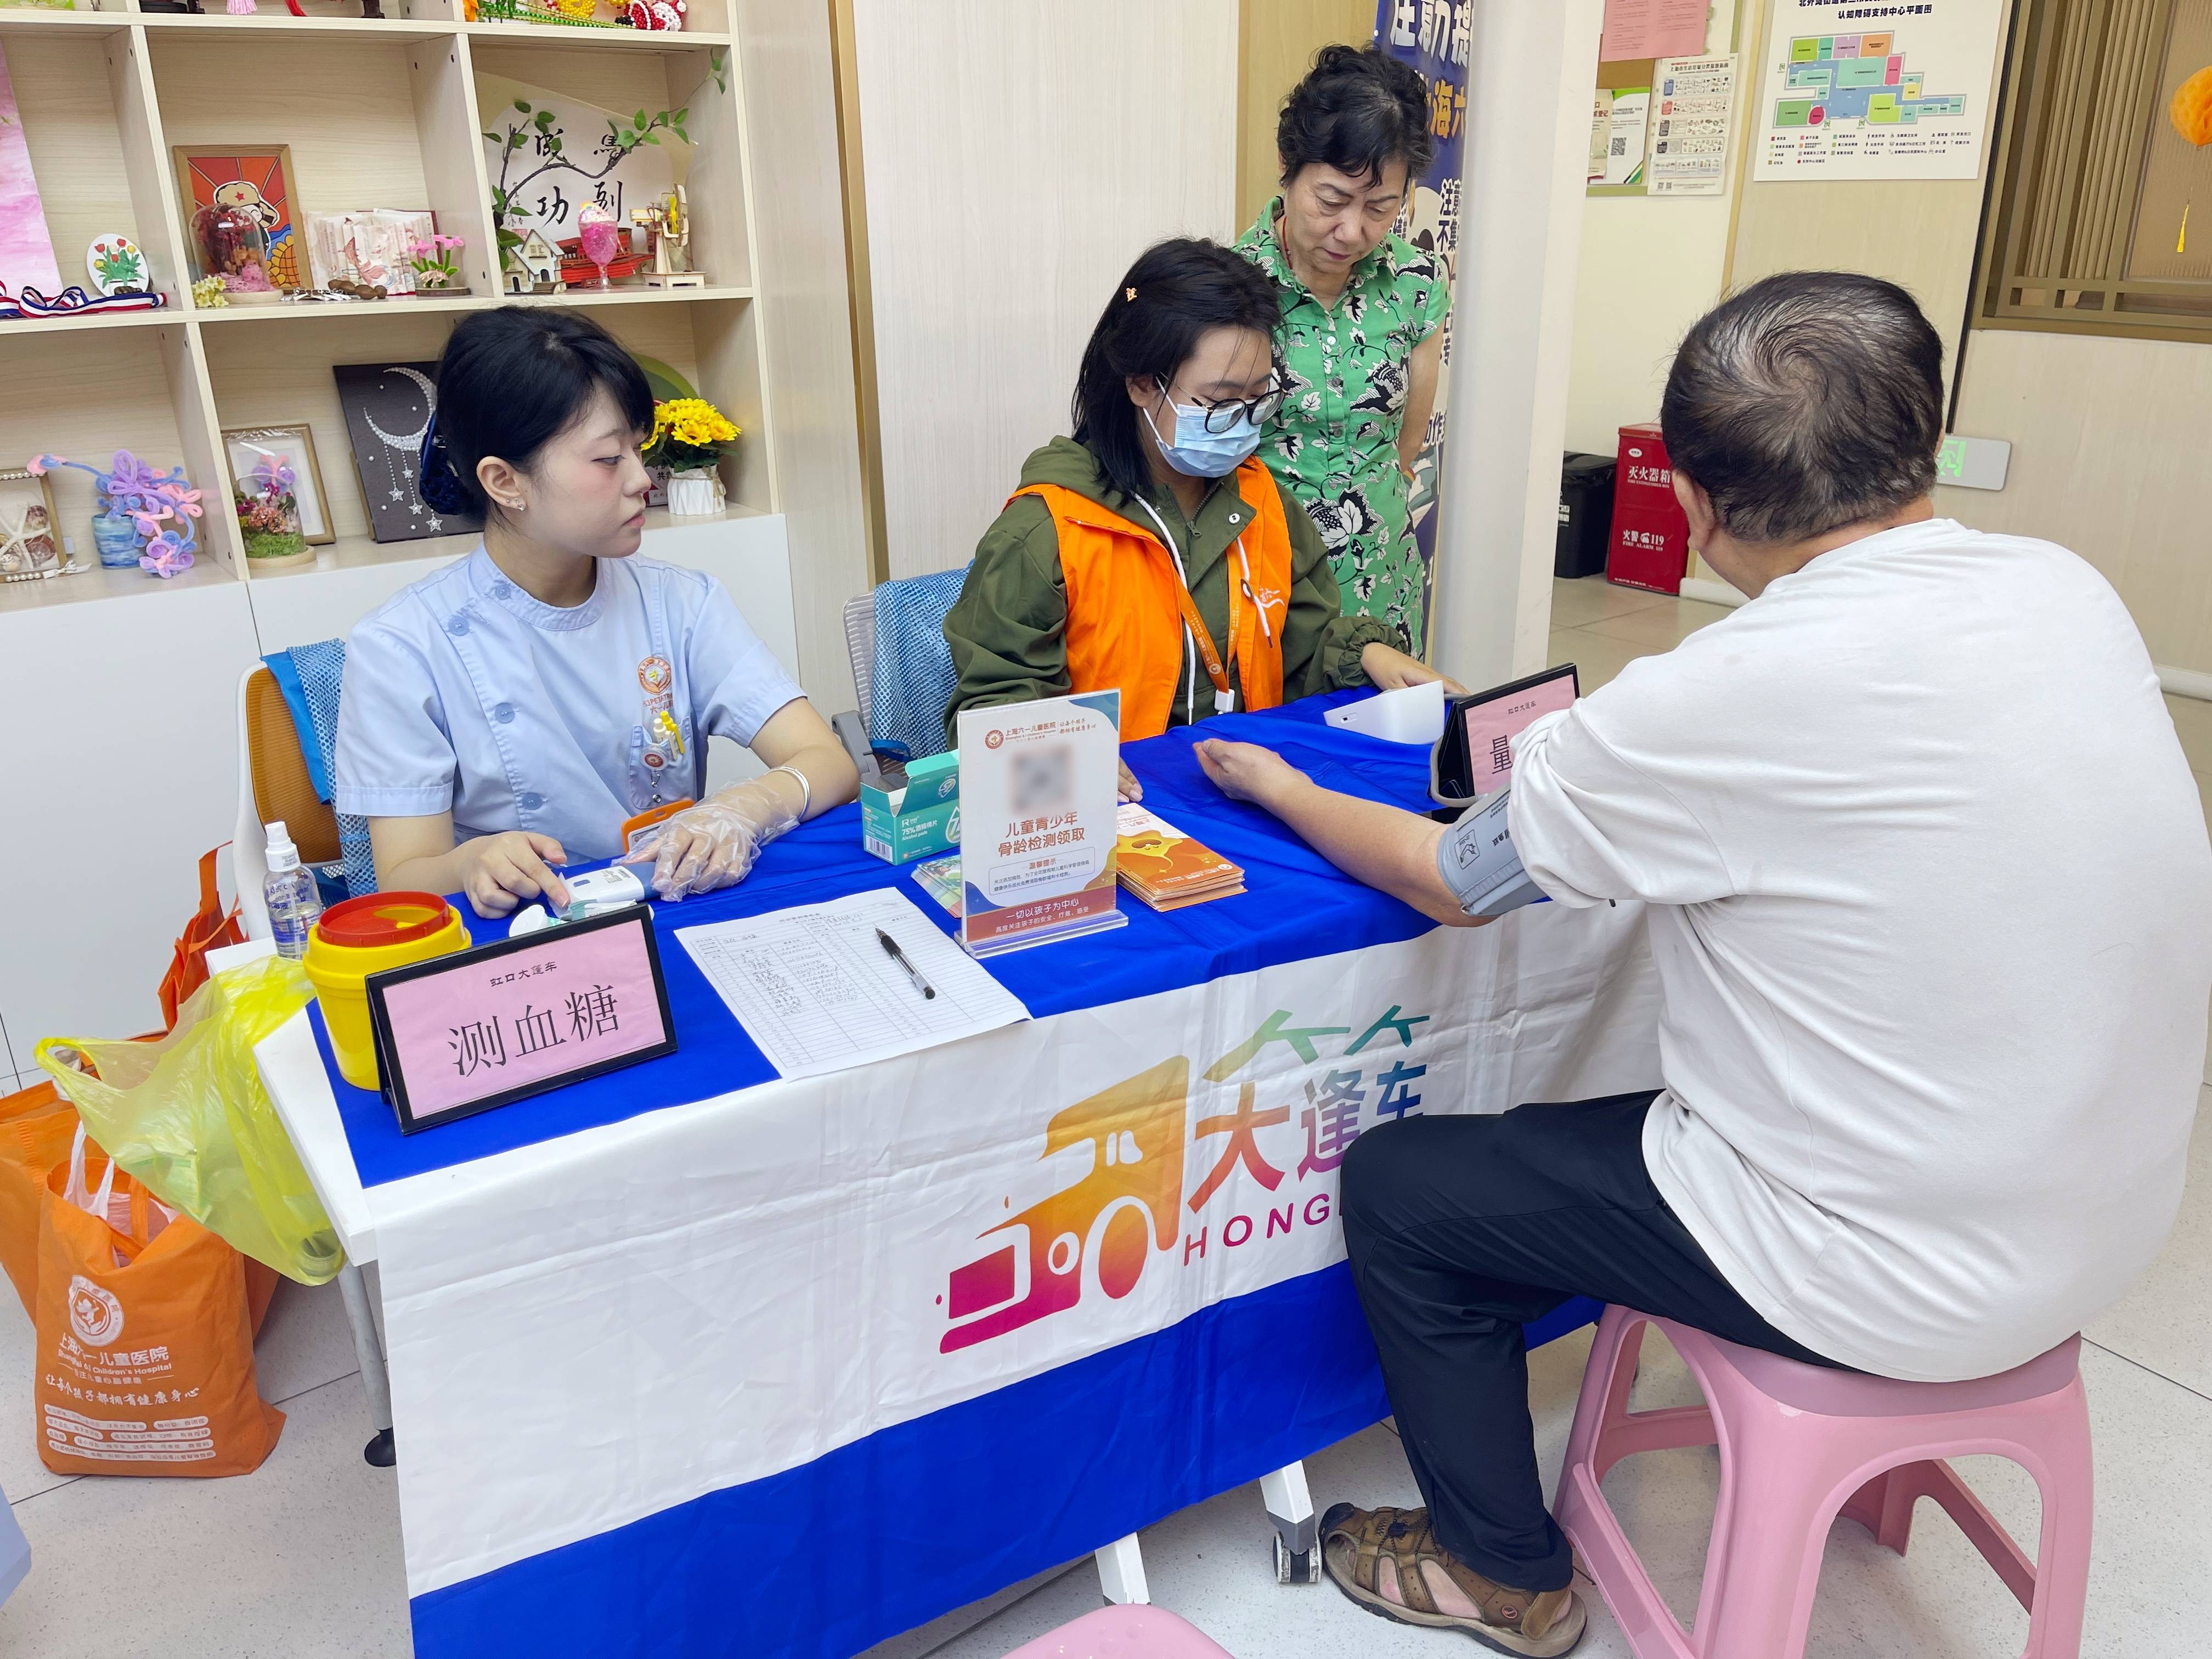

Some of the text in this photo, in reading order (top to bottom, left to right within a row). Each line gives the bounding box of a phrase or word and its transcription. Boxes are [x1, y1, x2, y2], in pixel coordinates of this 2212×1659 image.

[1838, 4, 1932, 19] 认知障碍支持中心平面图
[1628, 466, 1671, 483] 灭火器箱
[1623, 529, 1664, 545] 火警 119
[1005, 722, 1056, 736] 上海六一儿童医院
[1489, 735, 1513, 774] 量
[901, 820, 938, 836] 75%酒精棉片
[1005, 811, 1077, 838] 儿童青少年
[902, 832, 918, 841] Alcohol
[998, 827, 1085, 857] 骨龄检测领取
[1029, 857, 1057, 870] 温馨提示
[996, 906, 1089, 933] 高度关注孩子的安全、疗效、感受
[1006, 898, 1079, 919] 一切以孩子为中心
[490, 961, 557, 987] 虹口大篷车
[448, 984, 619, 1077] 测血糖
[1184, 1193, 1342, 1267] HONG
[59, 1333, 169, 1366] 上海六一儿童医院
[93, 1367, 133, 1375] Children's
[134, 1363, 172, 1375] Hospital
[46, 1373, 200, 1406] 让每个孩子都拥有健康身心
